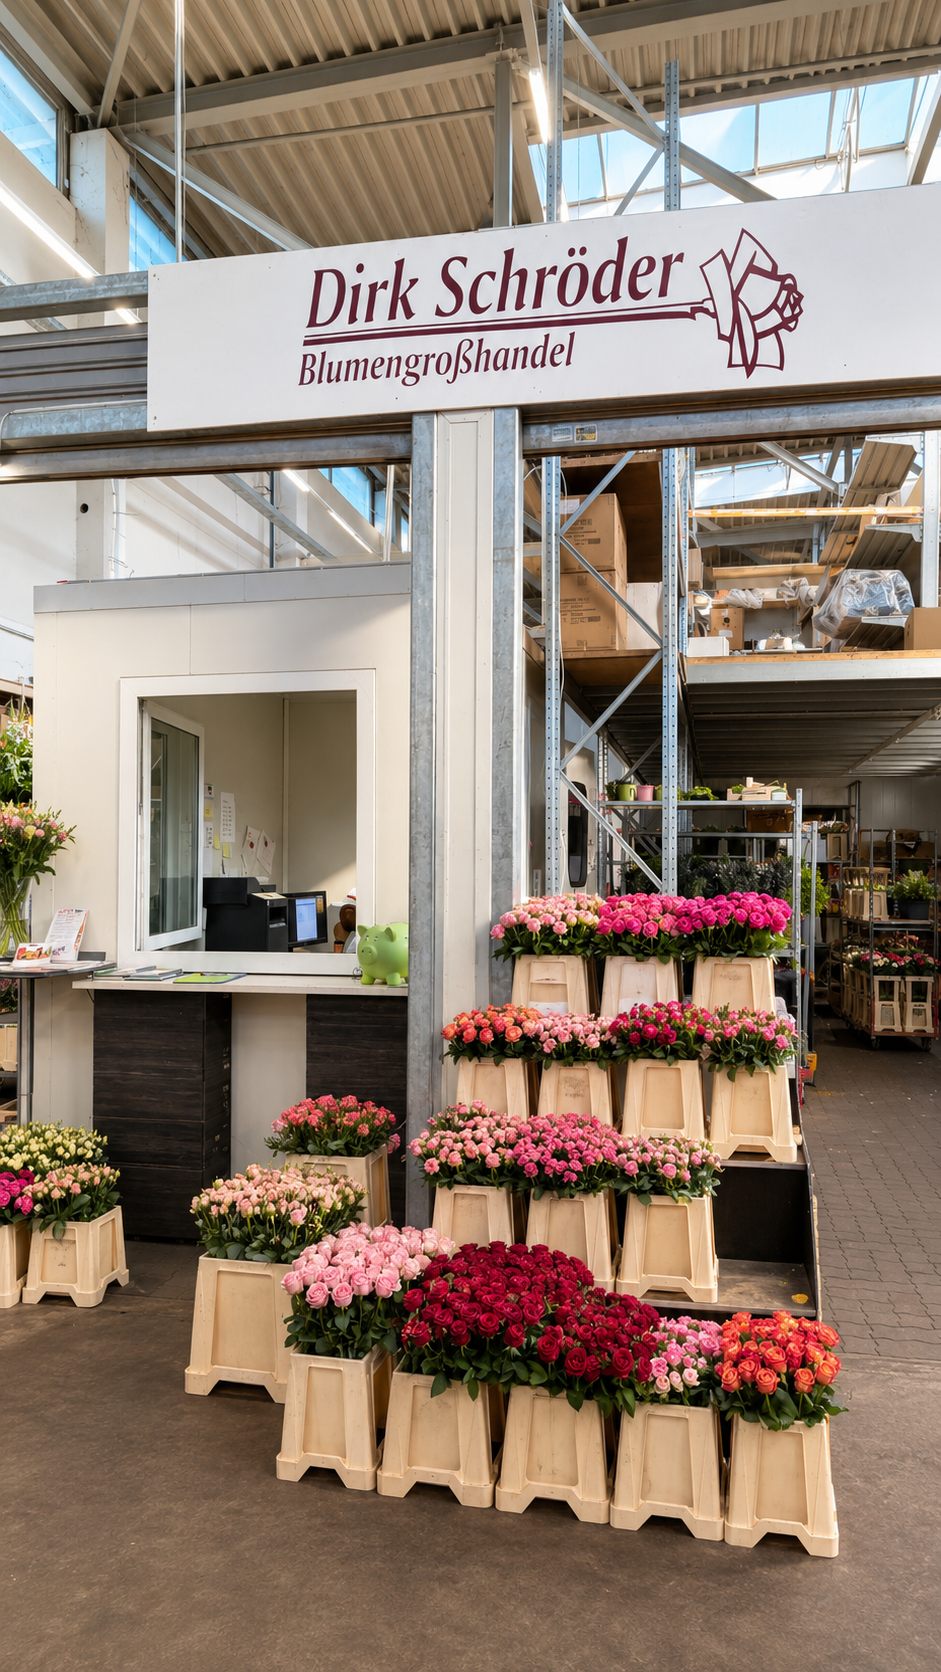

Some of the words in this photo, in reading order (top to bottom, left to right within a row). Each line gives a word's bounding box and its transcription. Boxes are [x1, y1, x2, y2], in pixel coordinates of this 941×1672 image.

[307, 258, 418, 328] Dirk
[434, 236, 684, 318] Schröder
[299, 331, 575, 387] Blumengroßhandel
